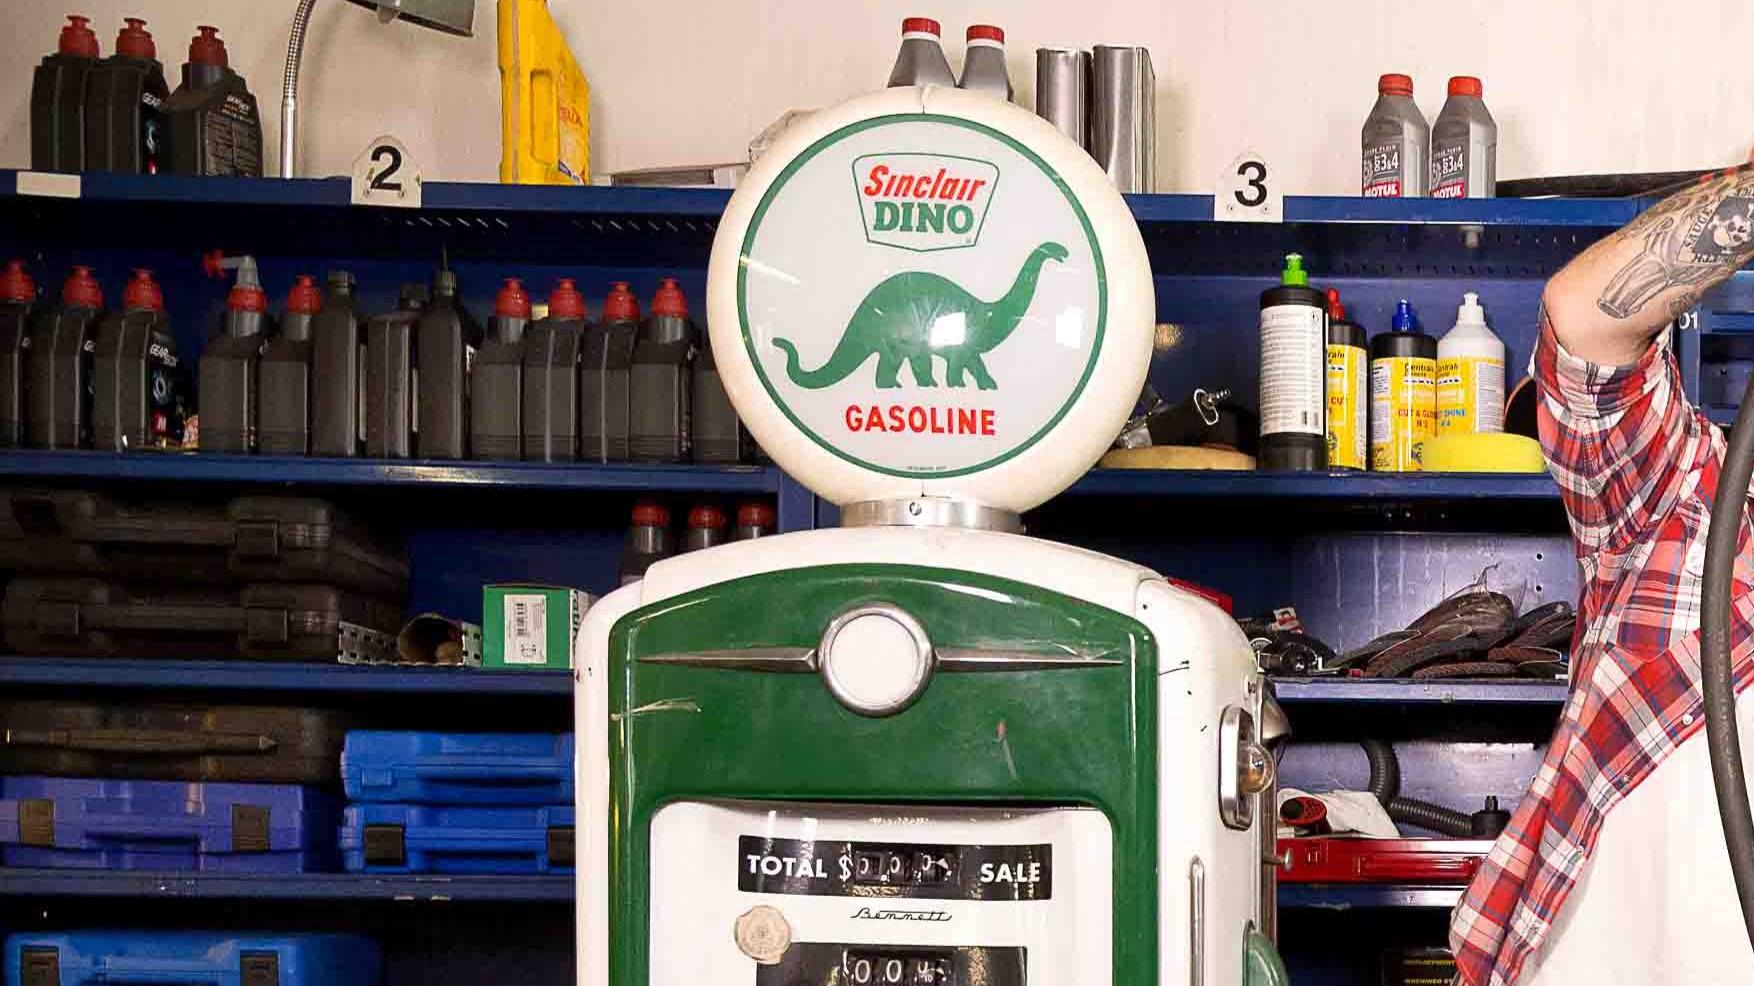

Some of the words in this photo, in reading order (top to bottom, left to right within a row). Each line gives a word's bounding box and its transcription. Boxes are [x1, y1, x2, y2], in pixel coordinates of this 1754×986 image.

[370, 145, 402, 191] 2
[863, 164, 986, 201] Sinclair
[1234, 160, 1268, 207] 3
[873, 200, 974, 235] DINO
[845, 403, 996, 436] GASOLINE
[747, 854, 827, 879] TOTAL
[980, 862, 1041, 884] SALE
[850, 907, 952, 921] Bennett
